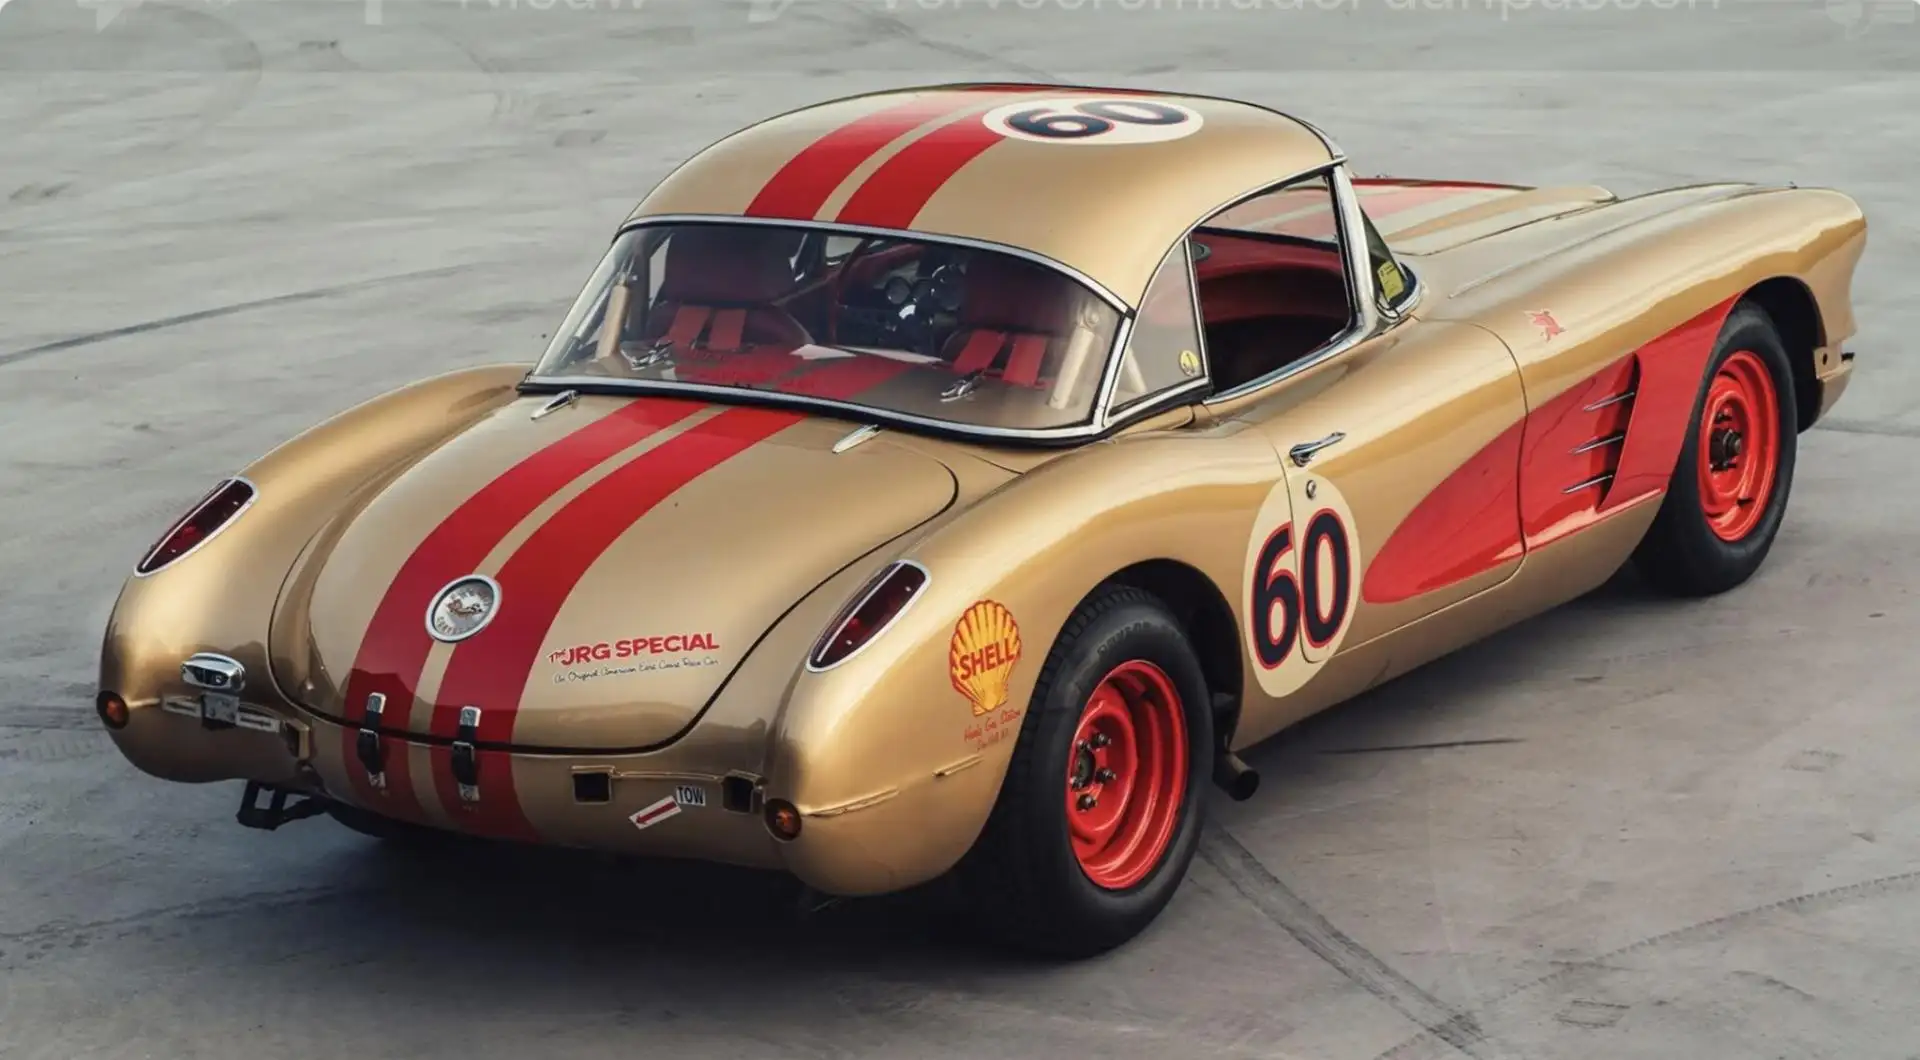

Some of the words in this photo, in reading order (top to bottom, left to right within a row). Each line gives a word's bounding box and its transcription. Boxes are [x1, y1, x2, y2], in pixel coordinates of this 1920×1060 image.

[1003, 101, 1189, 139] 60
[1251, 508, 1351, 670] 60
[562, 643, 610, 666] JRG
[616, 633, 720, 657] SPECIAL
[960, 638, 1015, 680] SHELL
[677, 787, 704, 805] TOW
